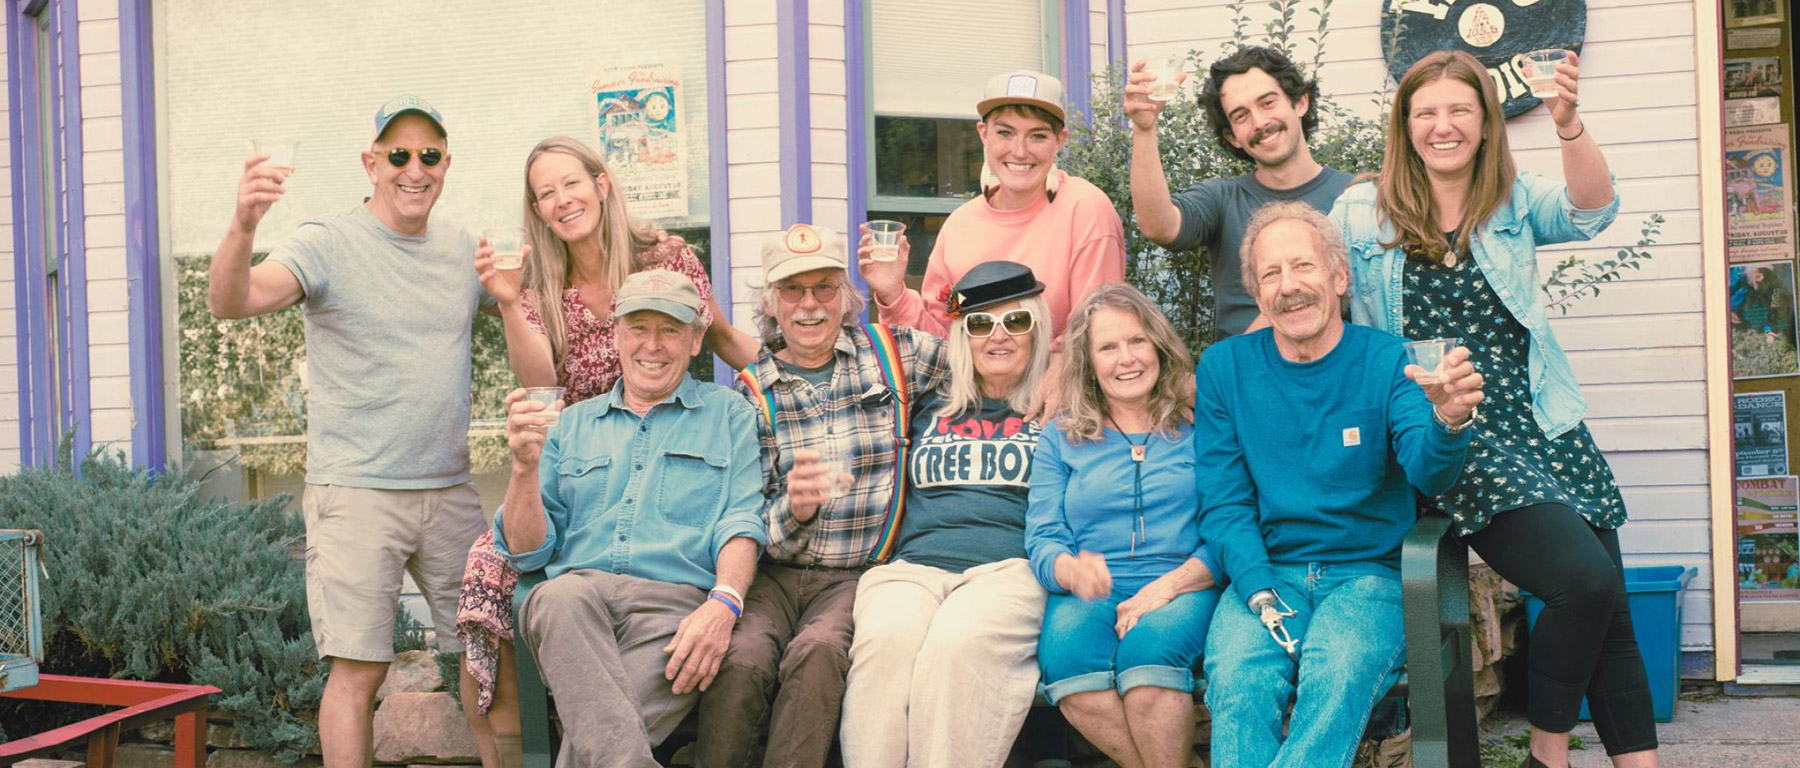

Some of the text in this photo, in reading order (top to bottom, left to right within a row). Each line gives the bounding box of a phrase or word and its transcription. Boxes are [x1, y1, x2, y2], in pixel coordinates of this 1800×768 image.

[1486, 53, 1531, 104] DIO
[1737, 396, 1781, 404] RODEO
[914, 442, 972, 485] FREE
